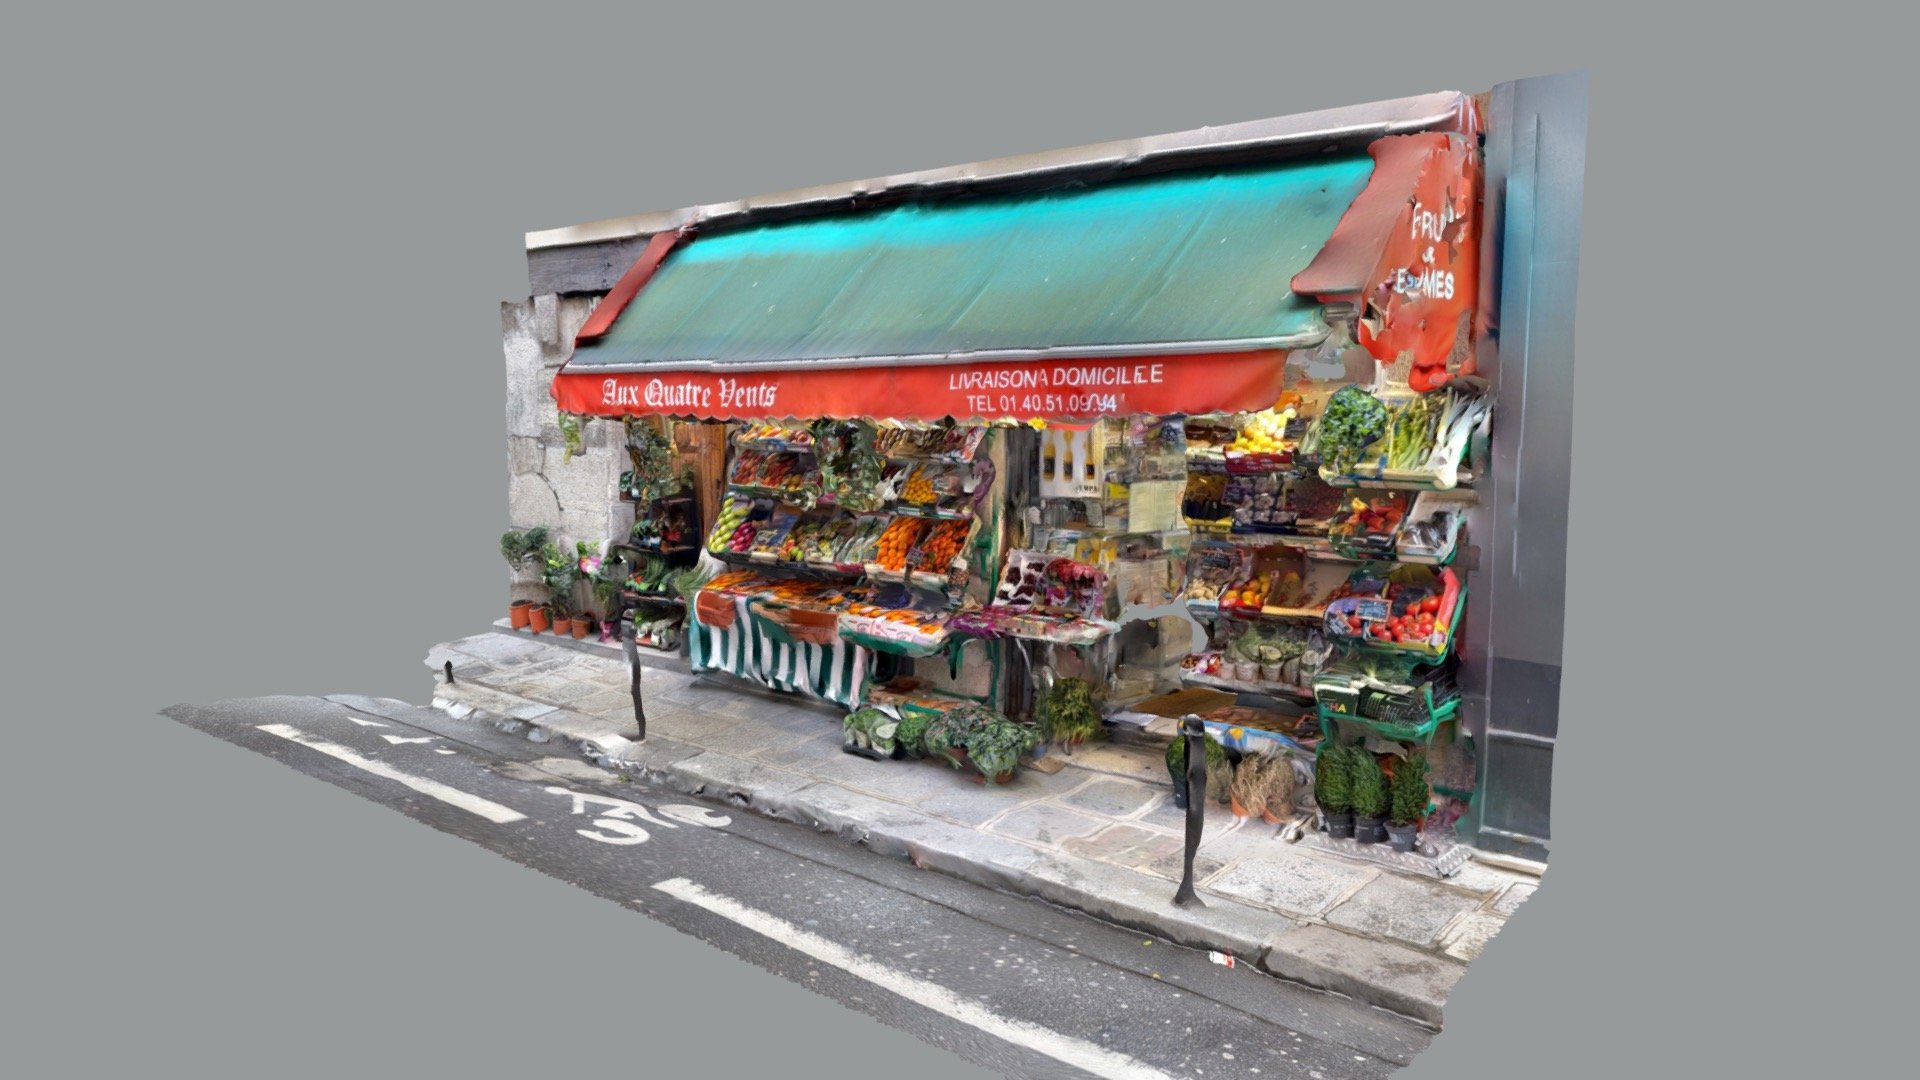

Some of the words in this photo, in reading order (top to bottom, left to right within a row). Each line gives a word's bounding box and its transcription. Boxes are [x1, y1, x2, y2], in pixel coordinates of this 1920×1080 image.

[602, 378, 639, 406] Aux
[644, 378, 712, 408] Quatre
[718, 378, 778, 407] Vents
[967, 394, 996, 412] TEL
